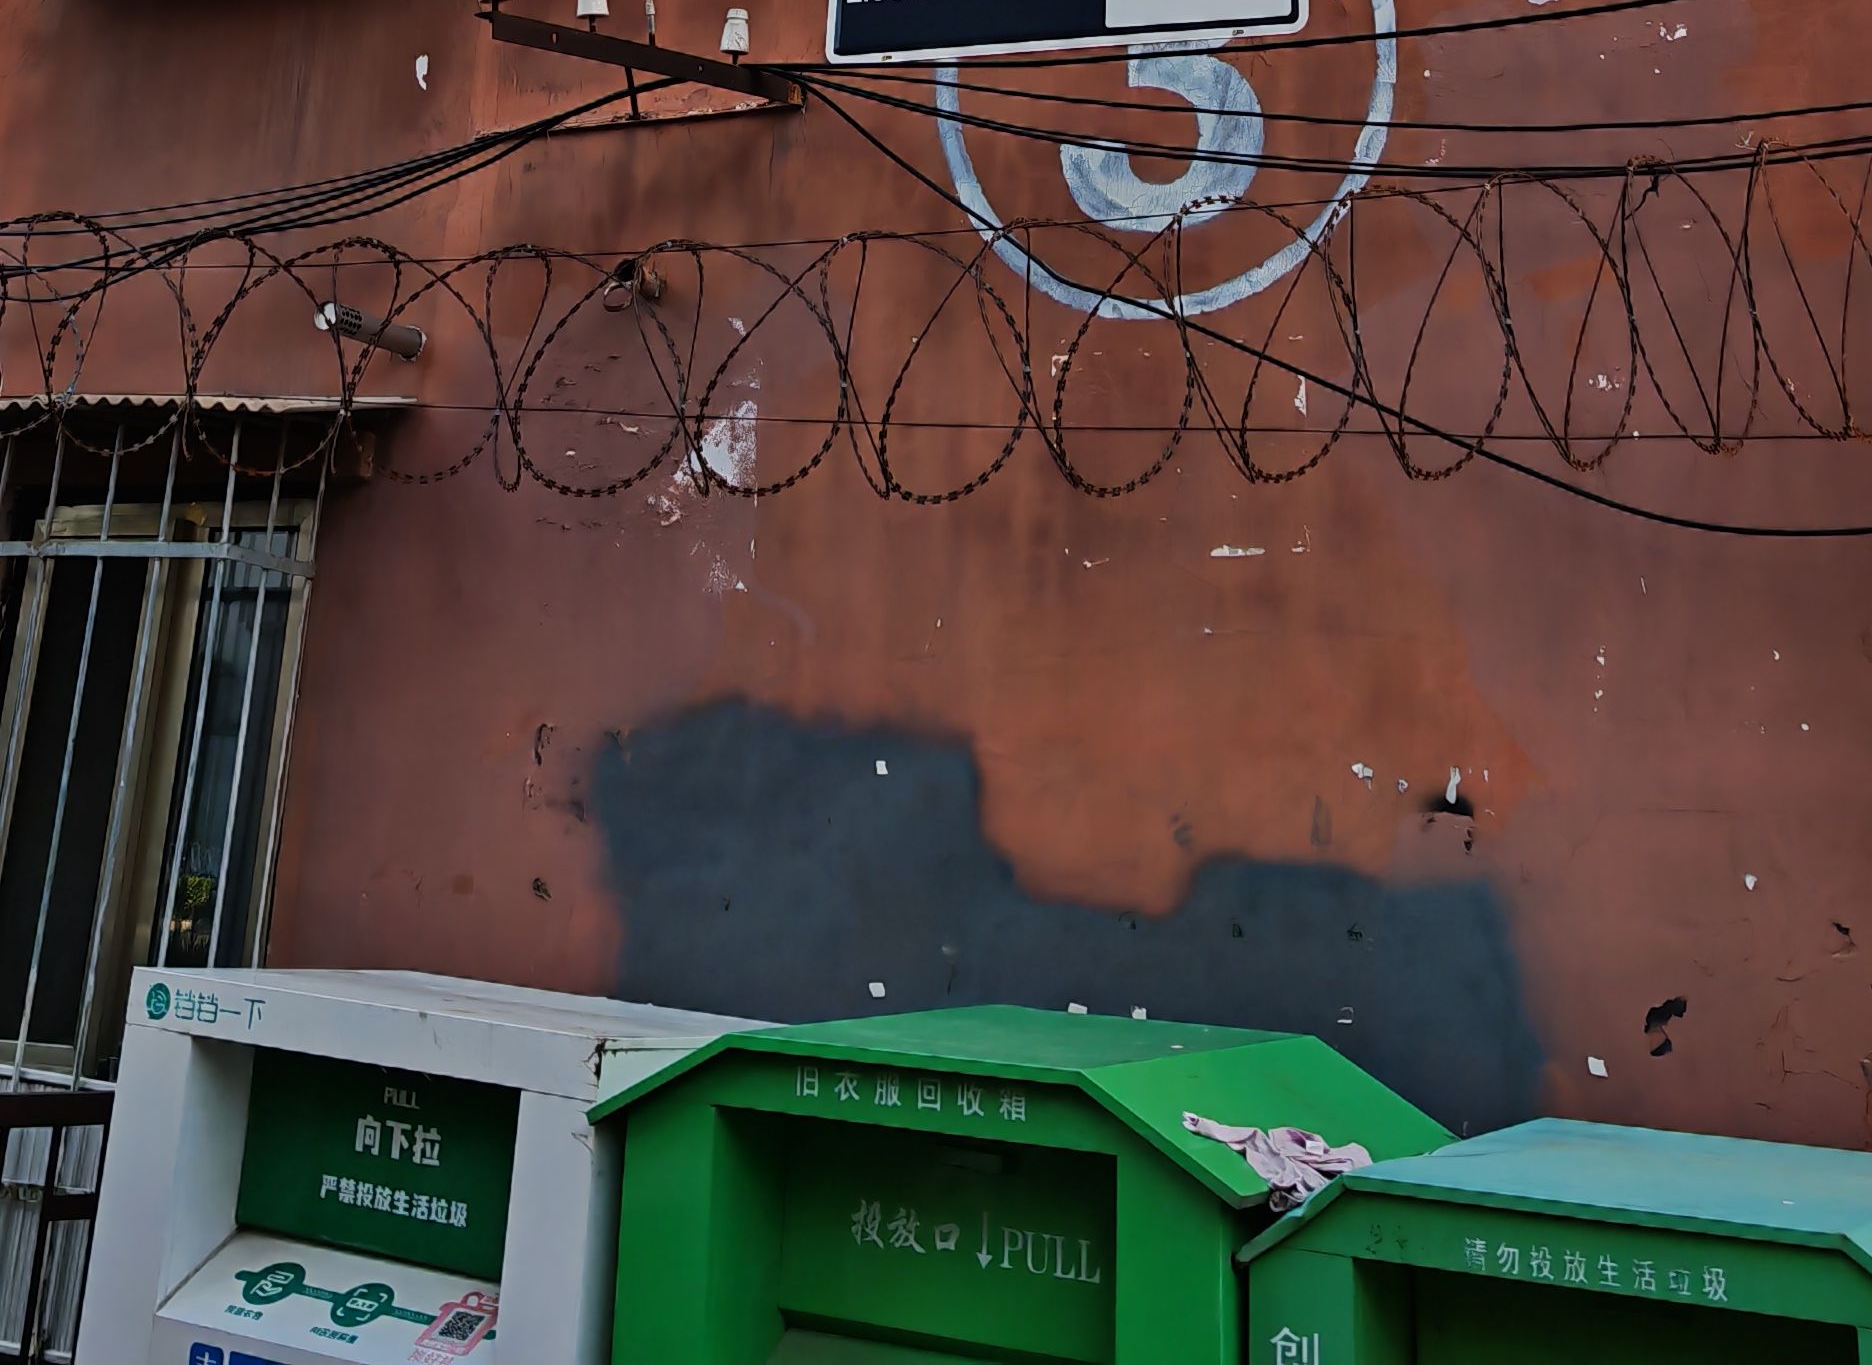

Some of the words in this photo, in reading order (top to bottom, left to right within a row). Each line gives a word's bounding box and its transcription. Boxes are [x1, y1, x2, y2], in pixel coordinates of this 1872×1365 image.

[383, 1085, 420, 1110] PULL
[796, 1066, 1027, 1122] 旧衣服回收箱
[354, 1114, 442, 1167] 向下拉
[319, 1173, 468, 1228] 严禁投放生活垃圾
[850, 1199, 961, 1254] 投放口
[1000, 1226, 1100, 1285] PULL
[1464, 1236, 1729, 1303] 请勿投放生活垃圾
